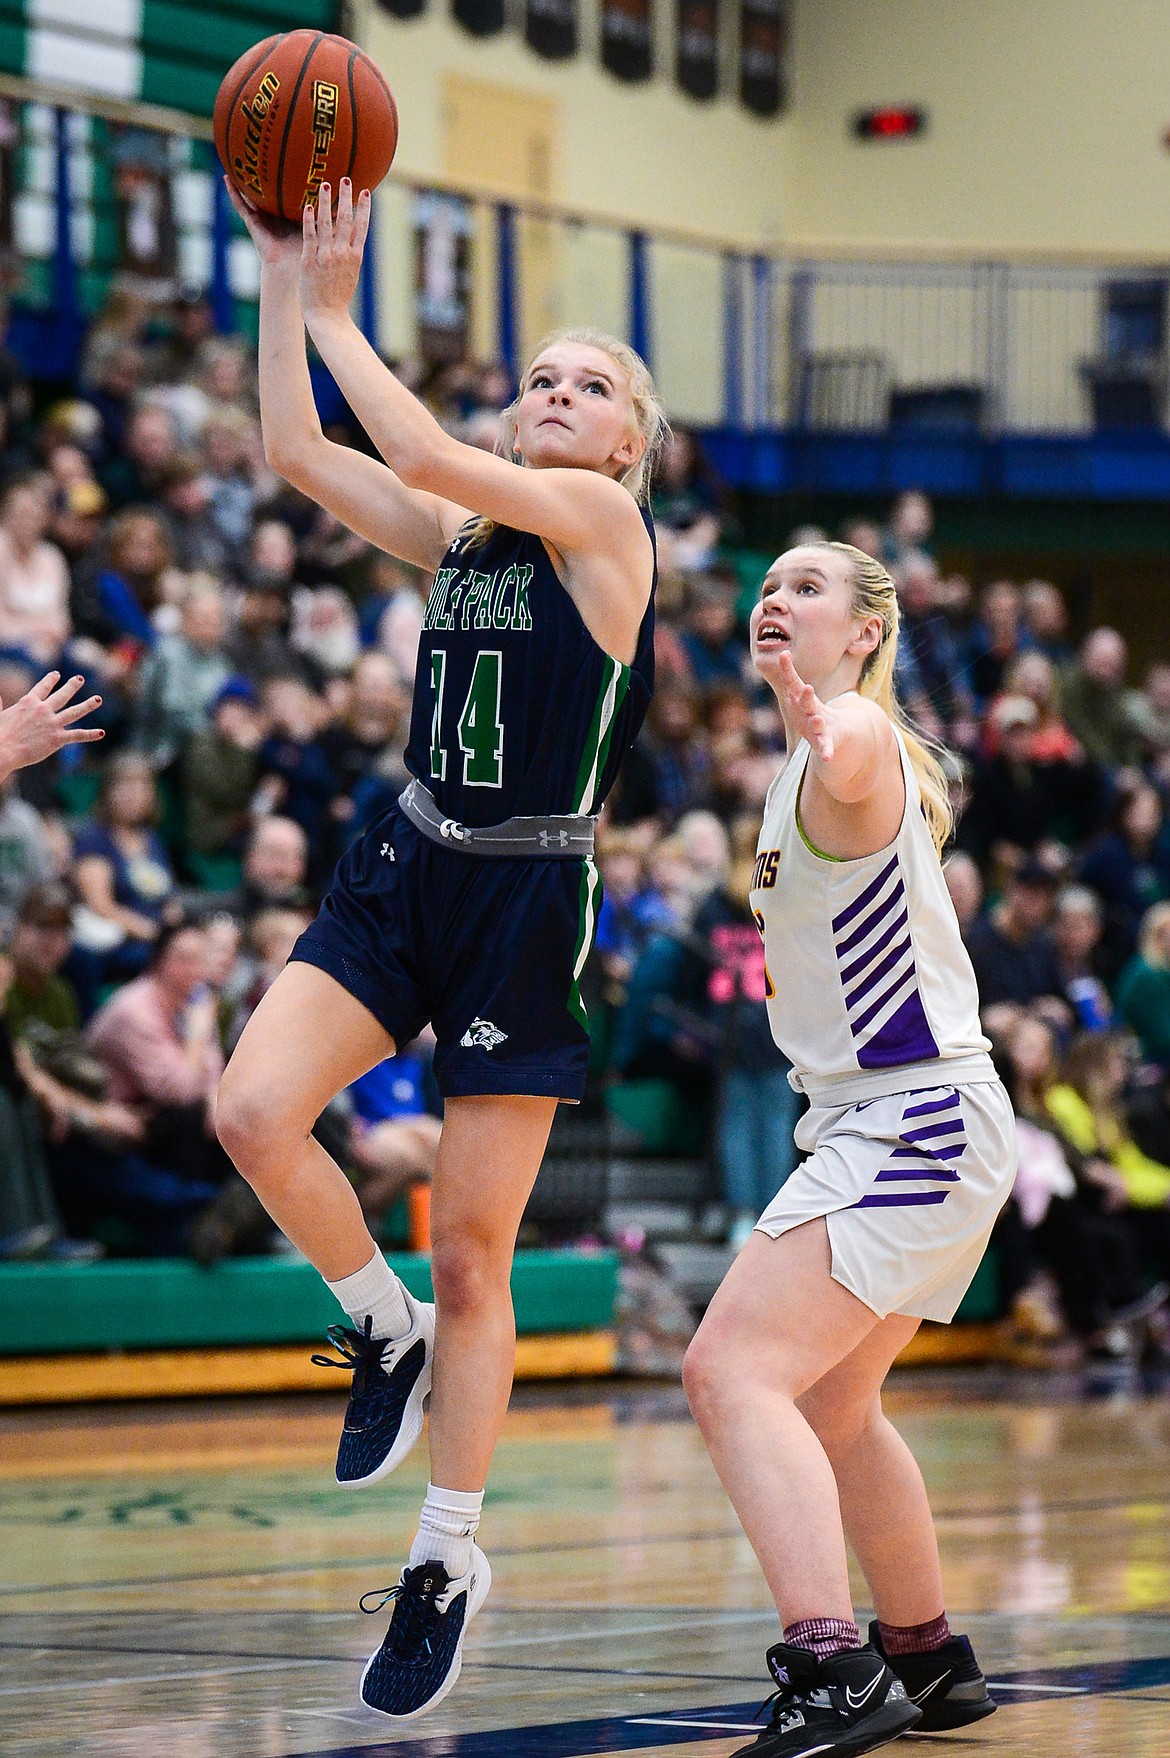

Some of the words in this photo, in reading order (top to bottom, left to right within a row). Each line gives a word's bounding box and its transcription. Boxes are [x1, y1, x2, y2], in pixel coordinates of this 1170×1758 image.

[235, 71, 280, 199] Baden
[315, 83, 336, 129] PRO
[300, 130, 331, 209] ELITE
[430, 649, 504, 789] 14
